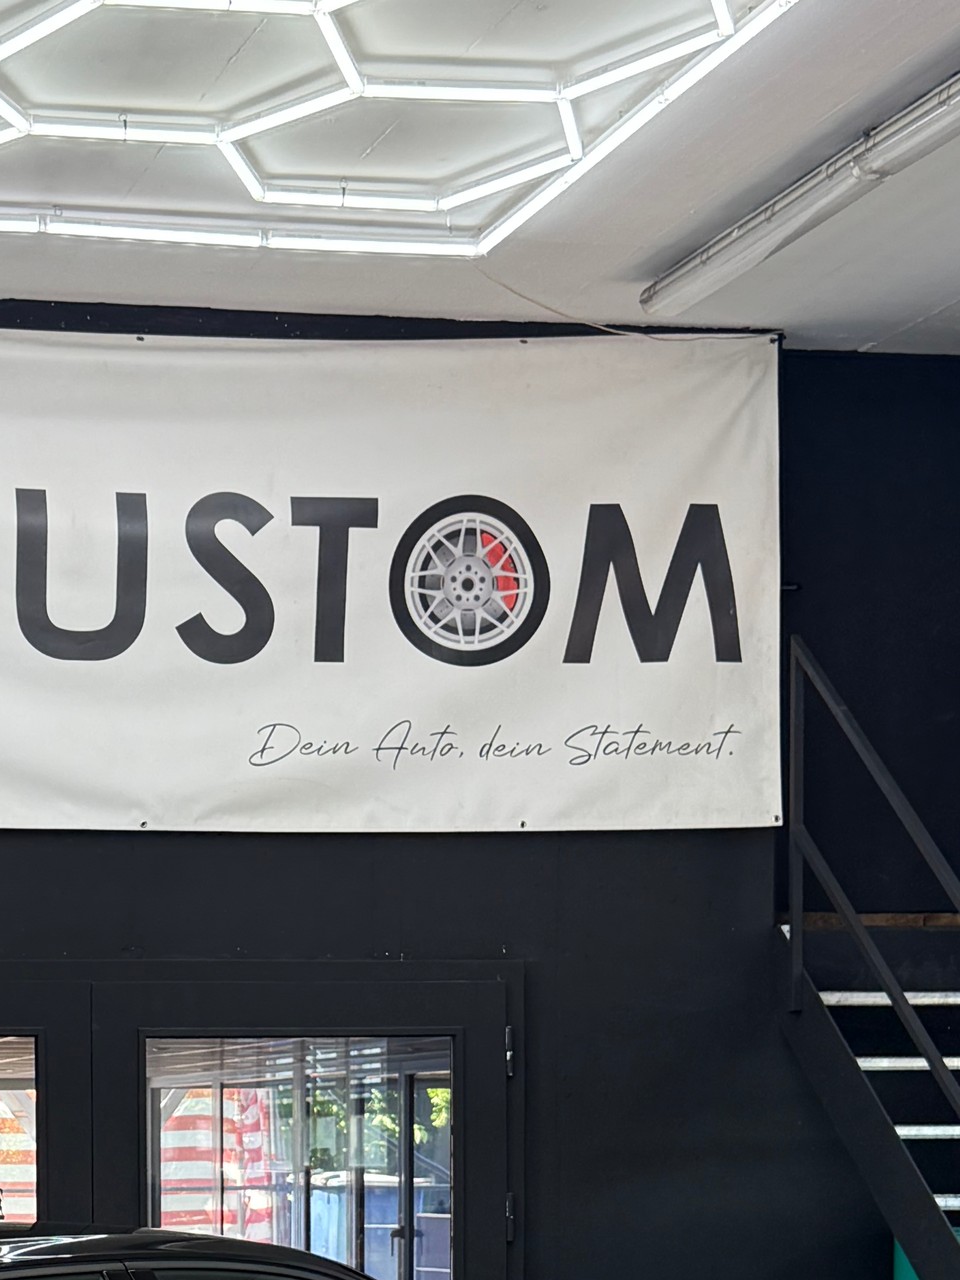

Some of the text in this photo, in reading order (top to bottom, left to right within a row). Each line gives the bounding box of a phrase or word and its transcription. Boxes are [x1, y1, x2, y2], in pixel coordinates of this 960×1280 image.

[248, 719, 744, 771] Dein Auto, dein Statement.
